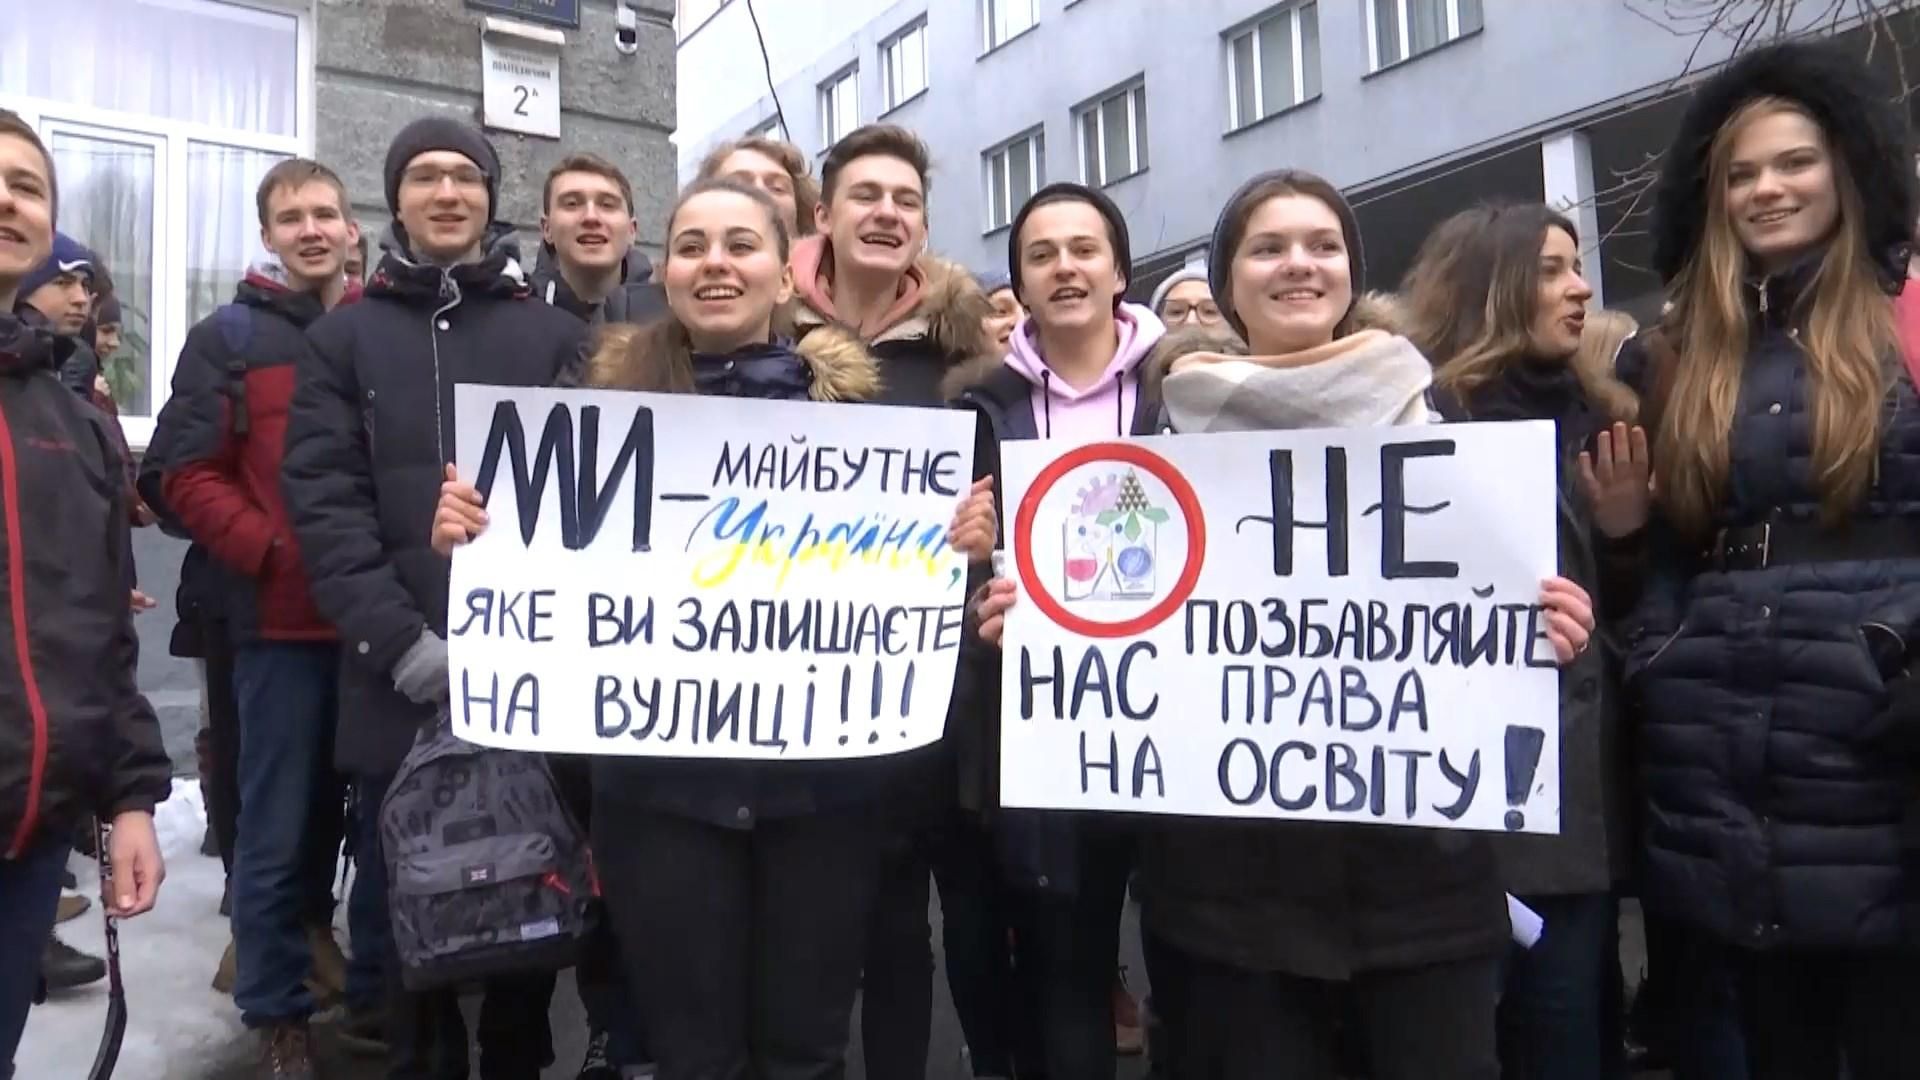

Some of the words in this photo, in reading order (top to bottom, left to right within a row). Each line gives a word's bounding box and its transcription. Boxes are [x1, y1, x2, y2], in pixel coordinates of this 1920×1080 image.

[468, 400, 654, 553] МИ
[712, 433, 961, 496] МАЙБУТНЄ
[1236, 439, 1459, 580] НЕ
[451, 587, 557, 643] ЯКЕ
[588, 592, 653, 648] ВИ
[672, 597, 963, 655] ЗАЛИШАЄТЕ
[1185, 583, 1557, 669] ПОЗБАВЛЯЙТЕ
[463, 666, 540, 737] НА
[1019, 640, 1159, 721] НАС
[1221, 665, 1430, 733] ПРАВА
[1079, 731, 1166, 799] НА
